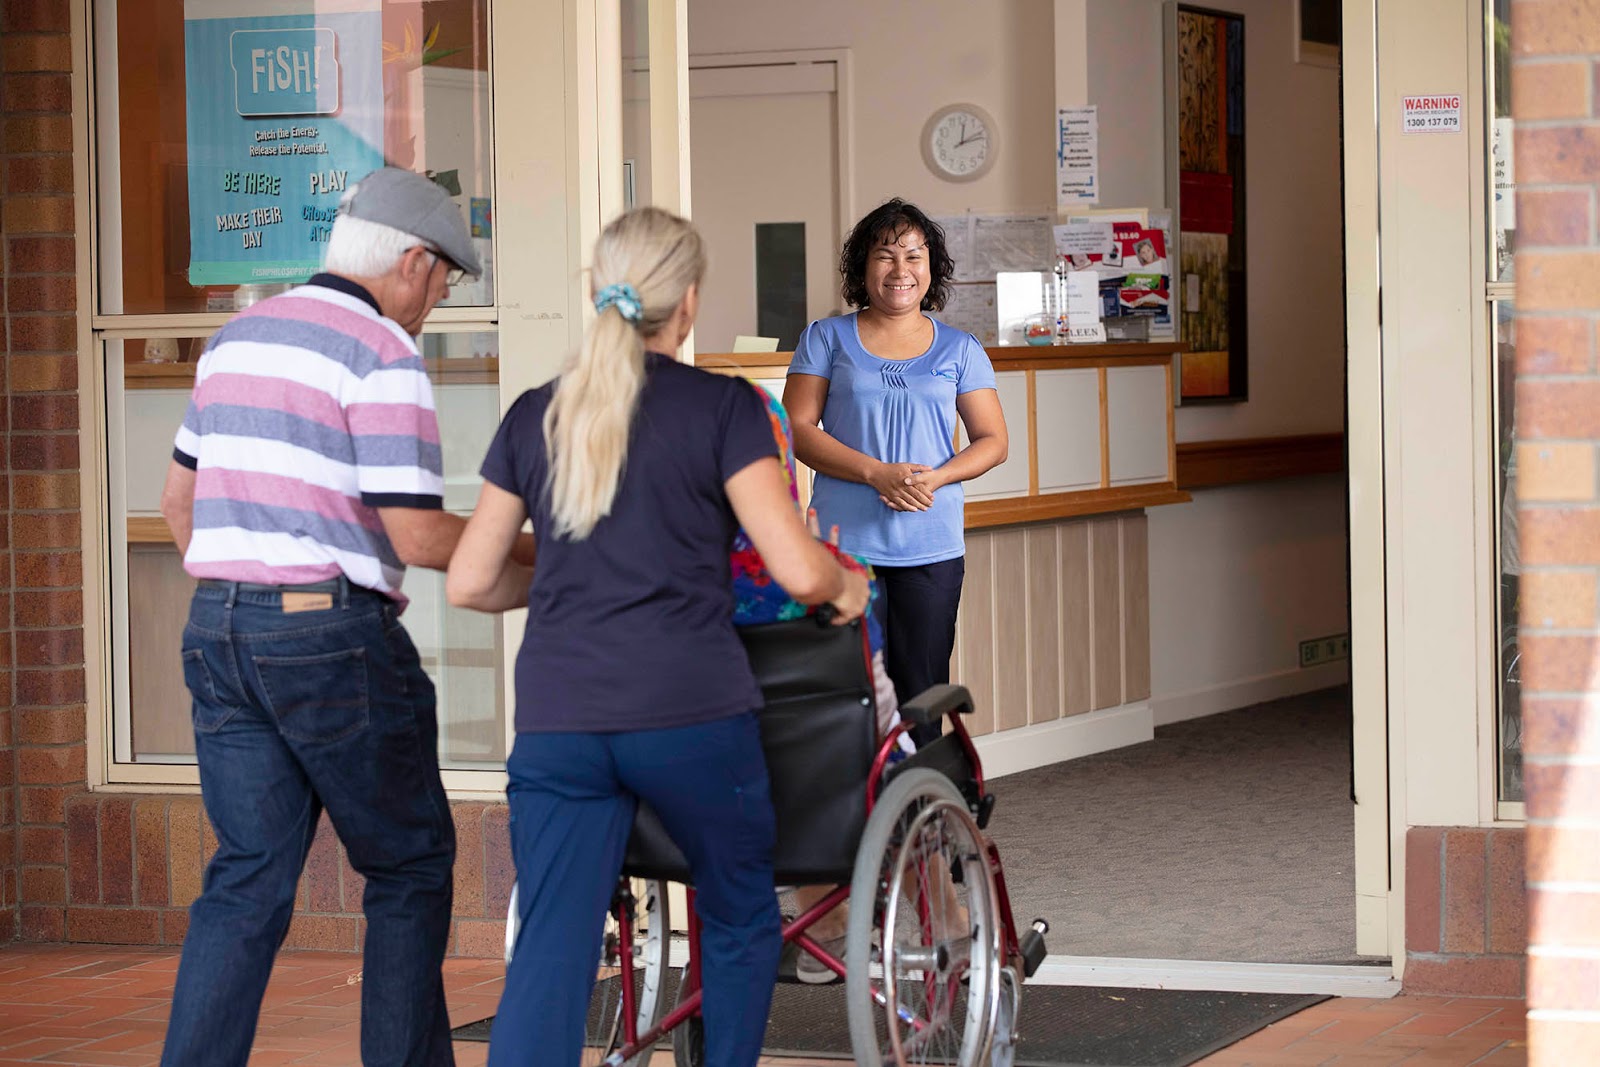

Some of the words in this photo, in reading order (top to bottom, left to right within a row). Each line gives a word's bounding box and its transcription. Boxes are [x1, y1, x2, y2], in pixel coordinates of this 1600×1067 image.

[1405, 98, 1459, 110] WARNING
[1407, 118, 1426, 127] 1300
[1428, 117, 1442, 126] 137
[1443, 117, 1458, 126] 079
[255, 130, 277, 142] Catch
[277, 127, 291, 138] the
[250, 145, 278, 157] Release
[278, 143, 292, 156] the
[293, 142, 328, 154] Potential.
[225, 171, 240, 192] BE
[243, 172, 281, 195] THERE
[310, 170, 347, 195] PLAY
[216, 212, 249, 231] MAKE
[243, 231, 262, 249] DAY
